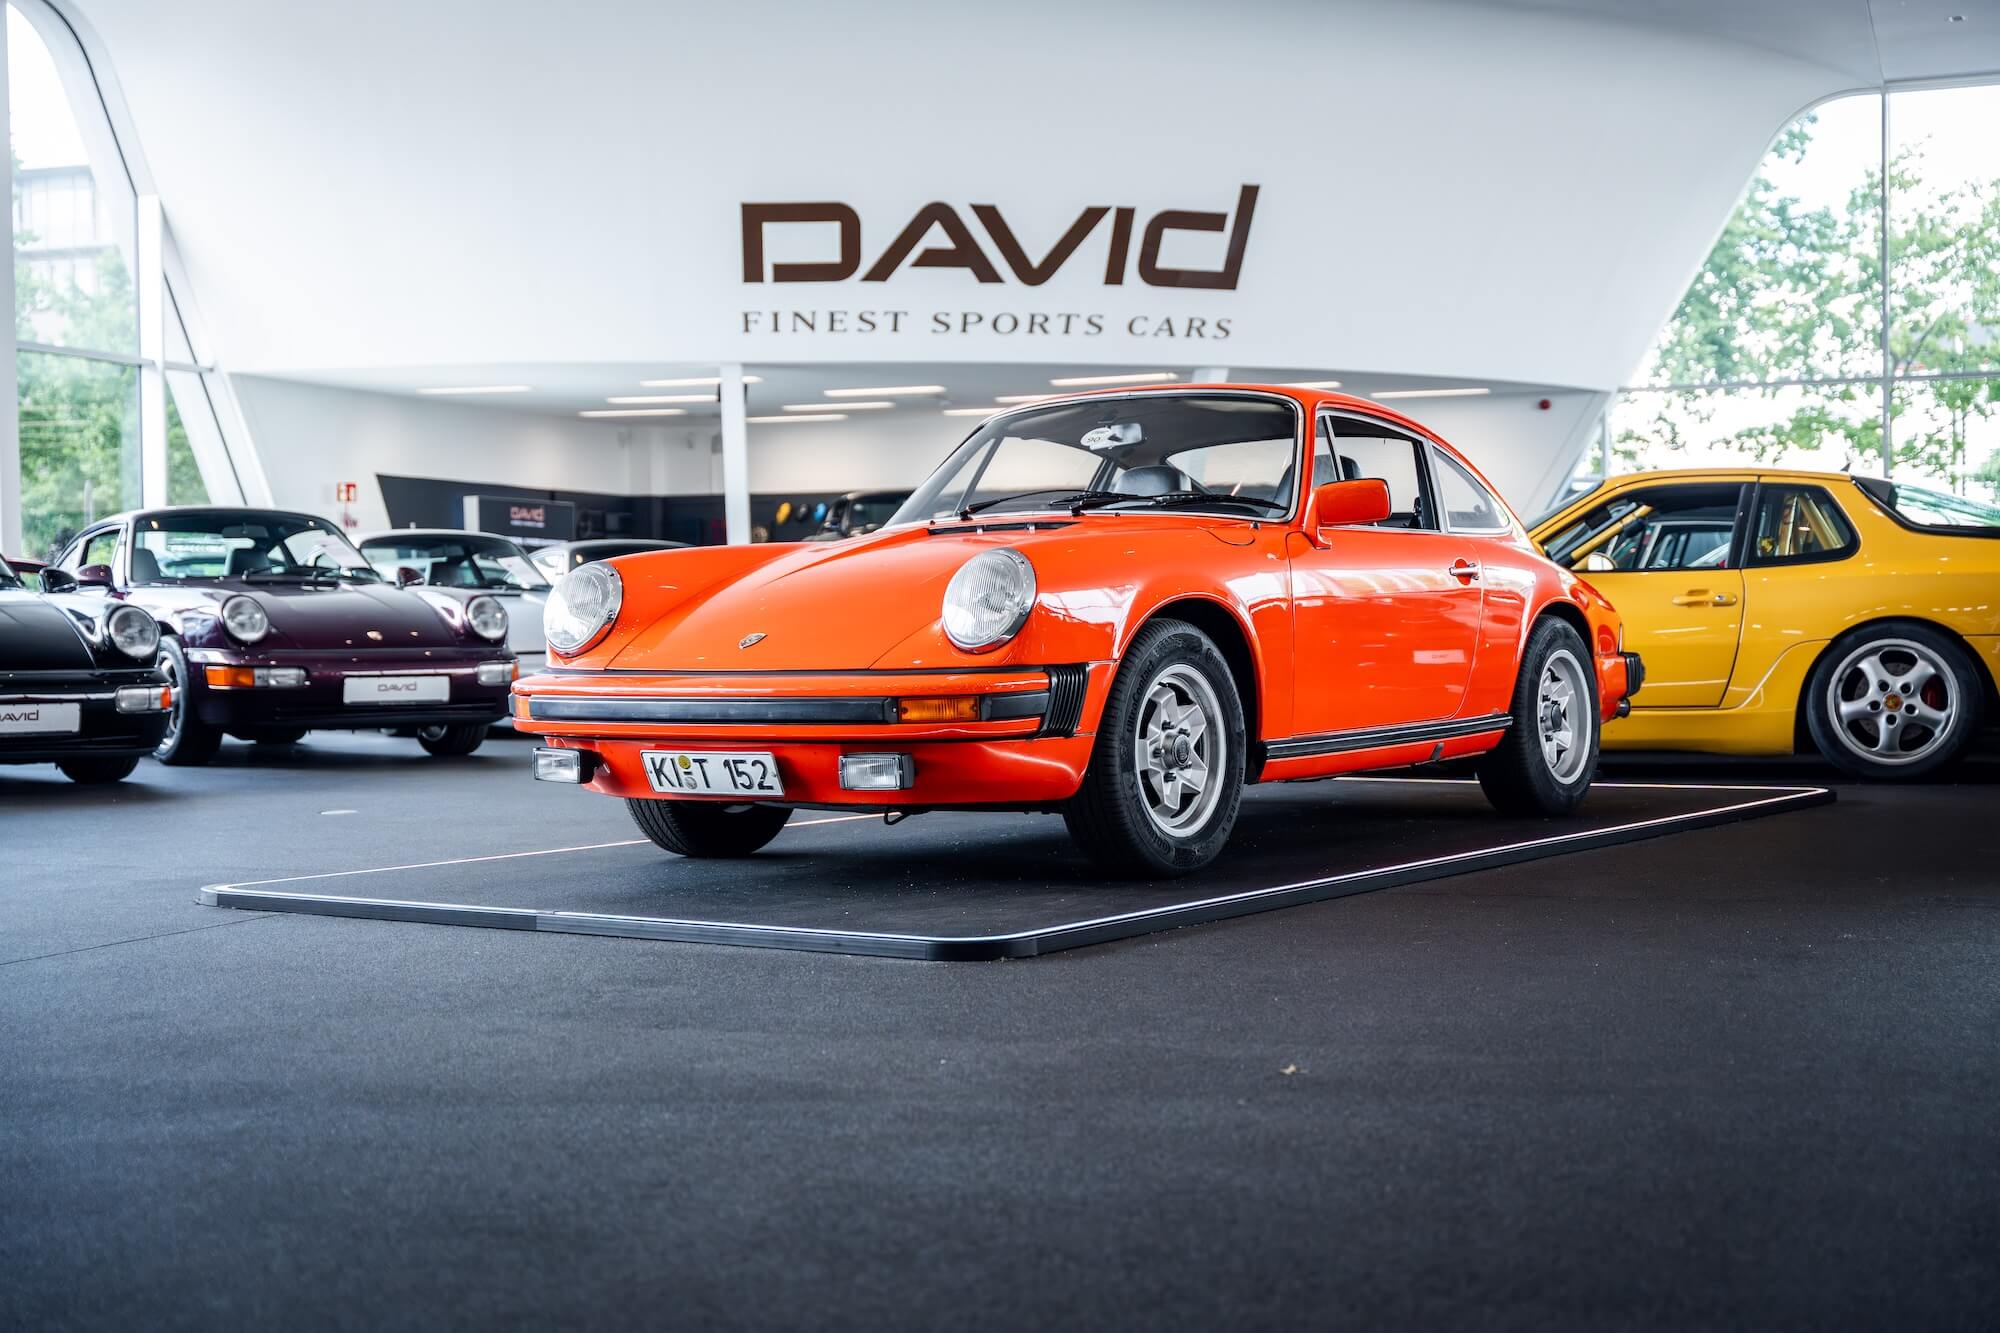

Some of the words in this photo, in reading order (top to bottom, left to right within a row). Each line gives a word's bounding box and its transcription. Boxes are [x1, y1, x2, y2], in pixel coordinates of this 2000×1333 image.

[742, 310, 909, 334] FINEST
[930, 311, 1105, 337] SPORTS
[1127, 316, 1232, 340] CARS
[723, 759, 774, 790] 152
